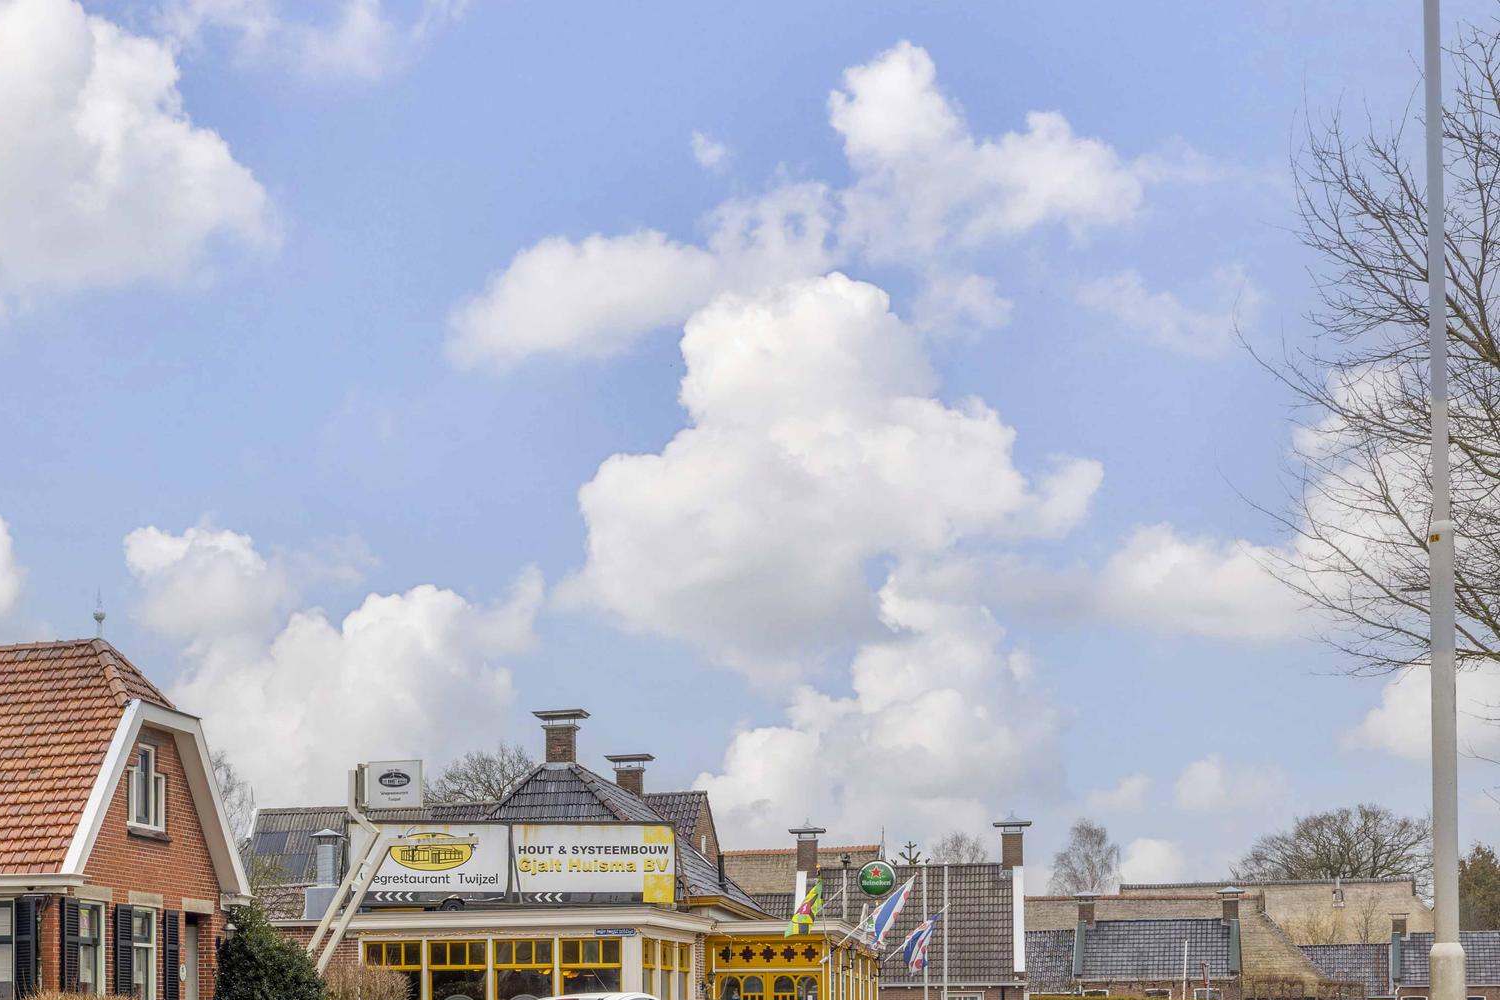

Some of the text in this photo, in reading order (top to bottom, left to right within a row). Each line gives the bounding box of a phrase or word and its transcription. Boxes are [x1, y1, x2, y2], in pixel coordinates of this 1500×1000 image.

[518, 845, 669, 855] HOUT & SYSTEEMBOUW
[518, 857, 669, 876] Gjalt Huisma BV
[360, 872, 499, 886] egrestaurant Twijzel
